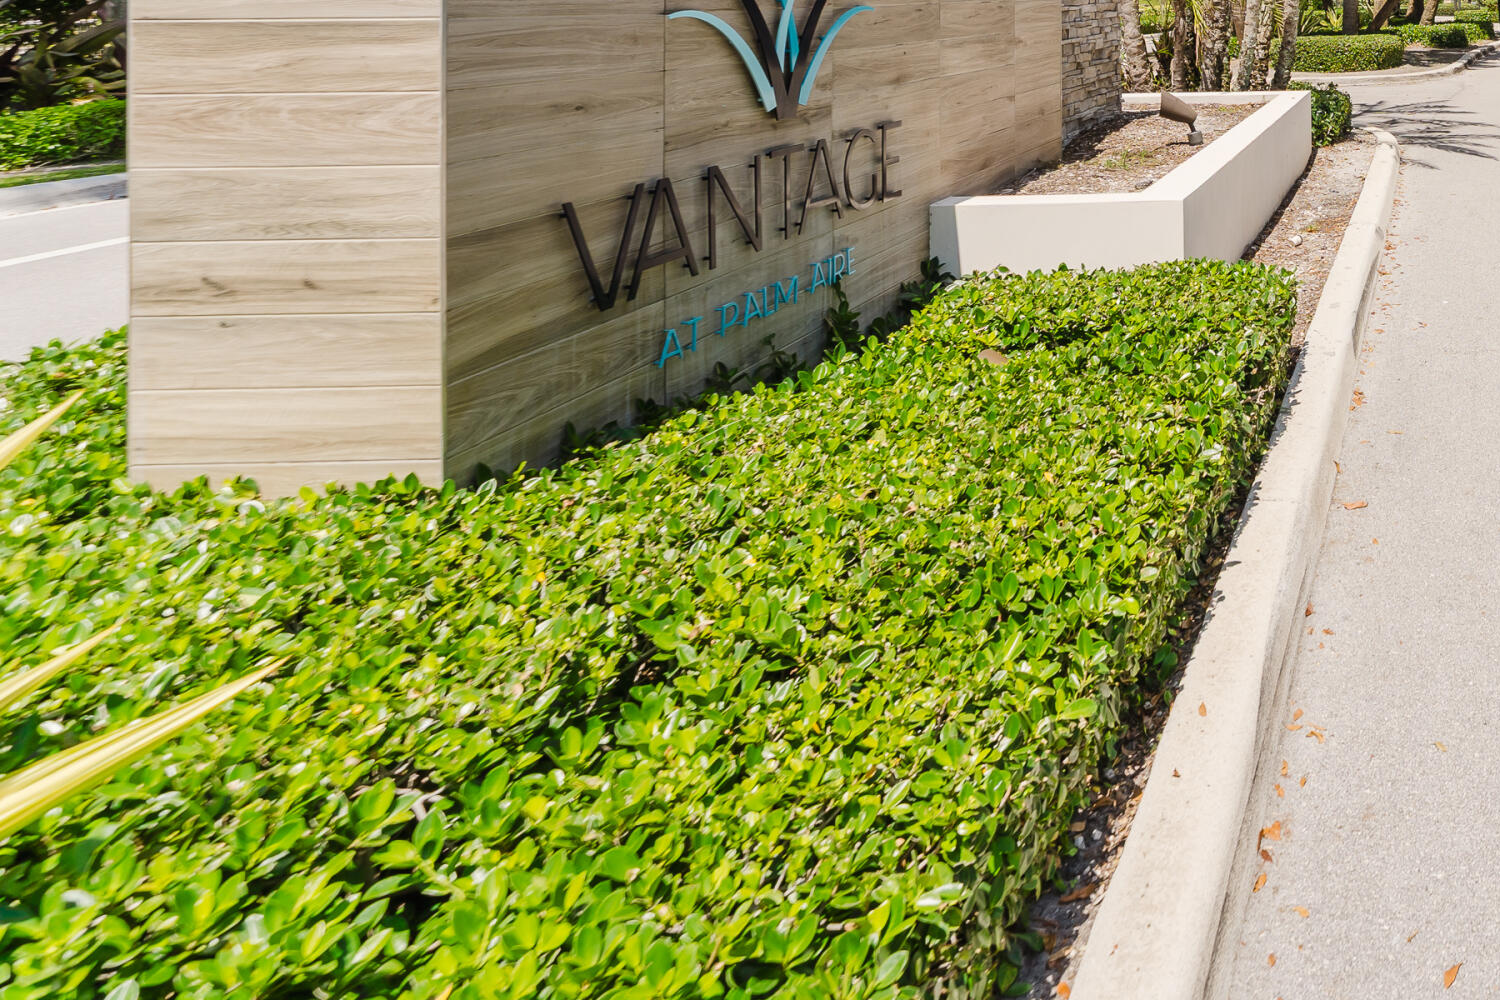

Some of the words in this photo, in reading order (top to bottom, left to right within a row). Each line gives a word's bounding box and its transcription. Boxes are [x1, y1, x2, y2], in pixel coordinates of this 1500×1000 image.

[560, 120, 902, 312] VANTAGE
[655, 316, 704, 368] AT
[716, 275, 798, 337] PALM
[807, 247, 856, 294] AIRE
